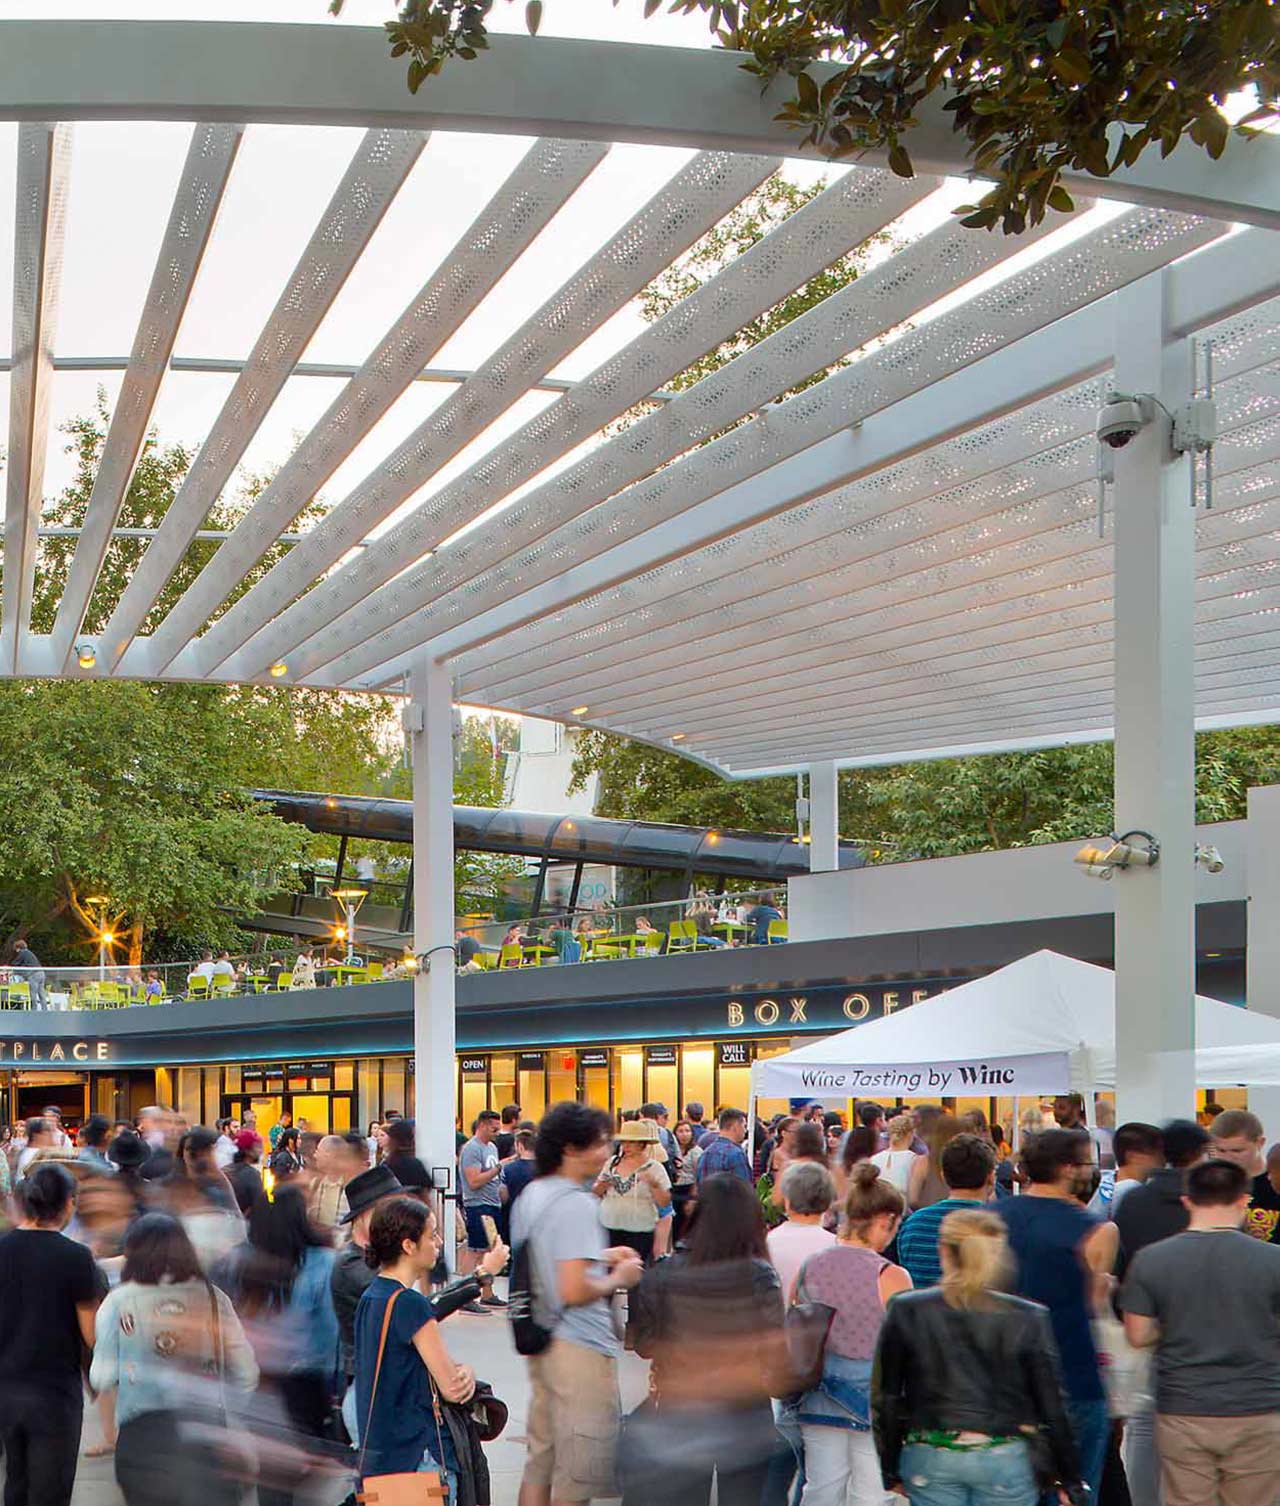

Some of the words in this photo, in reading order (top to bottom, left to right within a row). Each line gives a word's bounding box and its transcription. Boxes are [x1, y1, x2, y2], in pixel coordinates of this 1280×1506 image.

[728, 1000, 808, 1027] BOX
[843, 991, 949, 1020] OFF
[722, 1044, 745, 1054] WILL
[722, 1053, 745, 1063] CALL
[462, 1060, 484, 1069] OPEN
[801, 1069, 846, 1087] Wine
[851, 1069, 921, 1091] Tasting
[928, 1068, 952, 1091] by
[959, 1065, 1015, 1085] Winc
